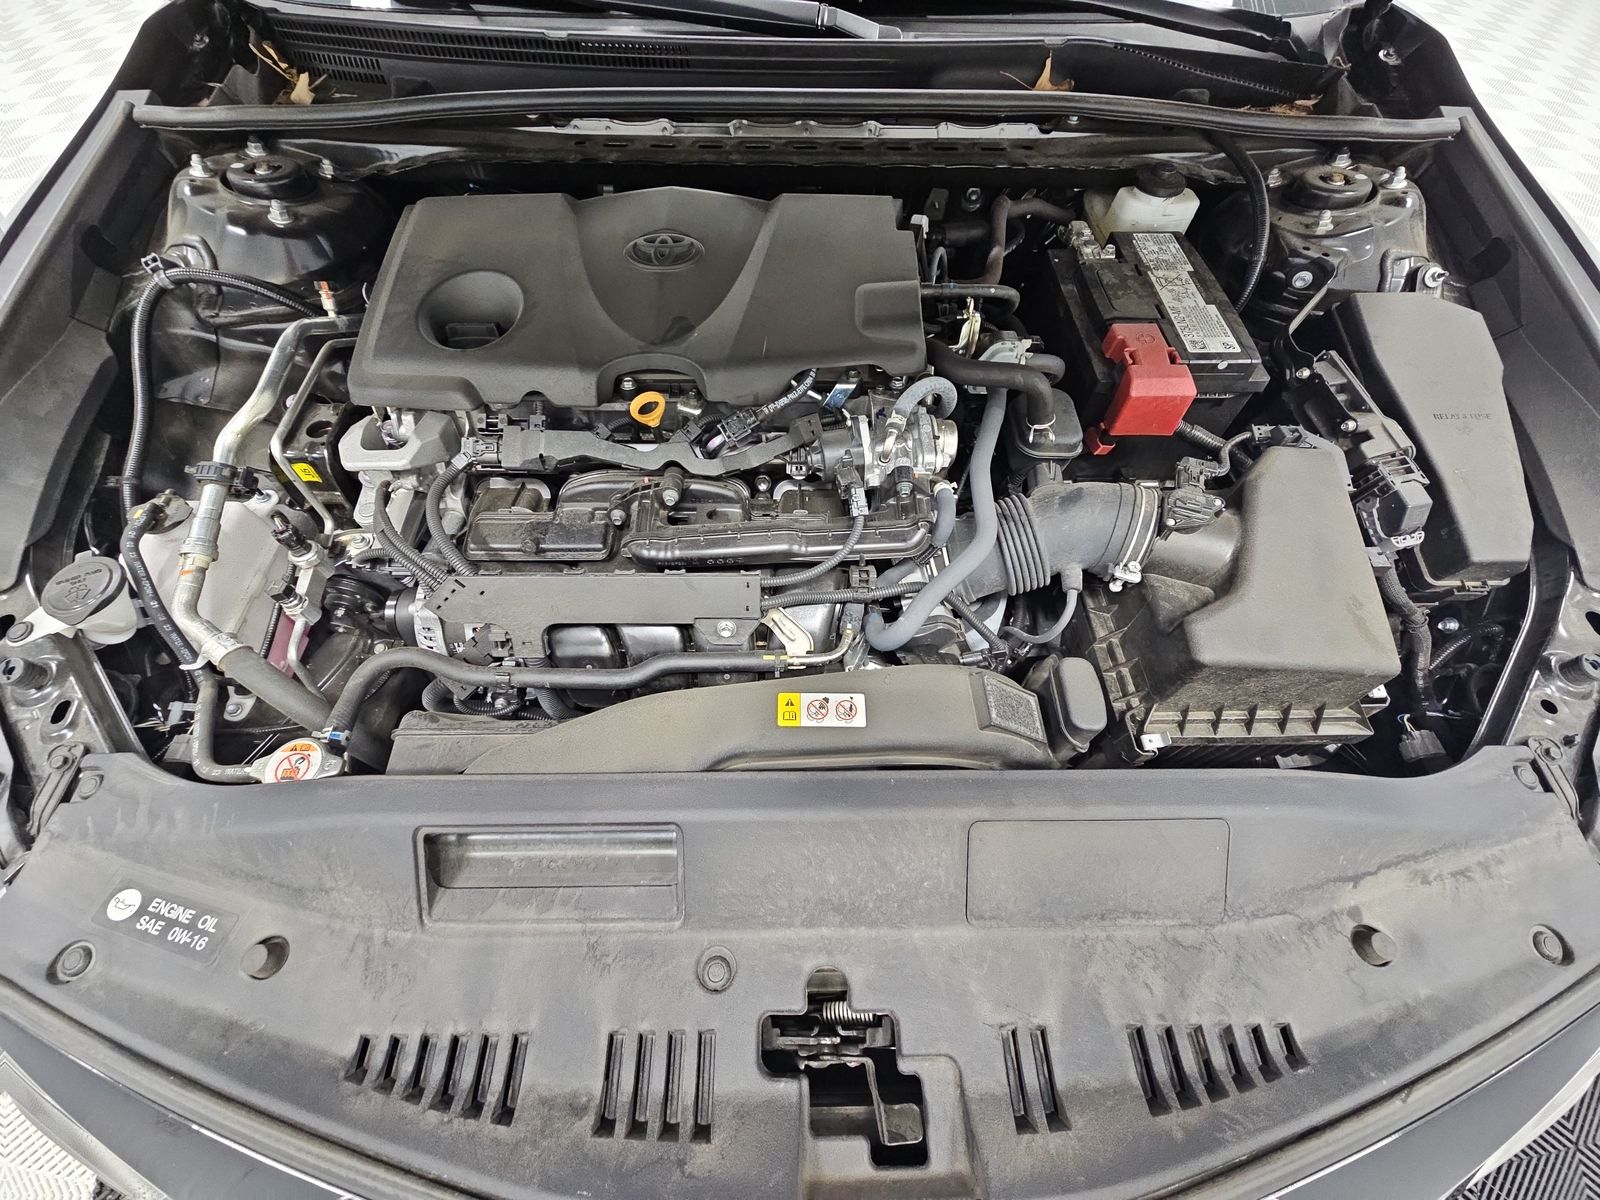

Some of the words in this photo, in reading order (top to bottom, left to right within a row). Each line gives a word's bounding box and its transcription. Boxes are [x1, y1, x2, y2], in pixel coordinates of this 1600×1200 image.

[135, 915, 166, 935] SAE
[167, 926, 209, 951] 0W-16
[147, 897, 197, 924] ENGINE
[197, 914, 219, 933] OIL
